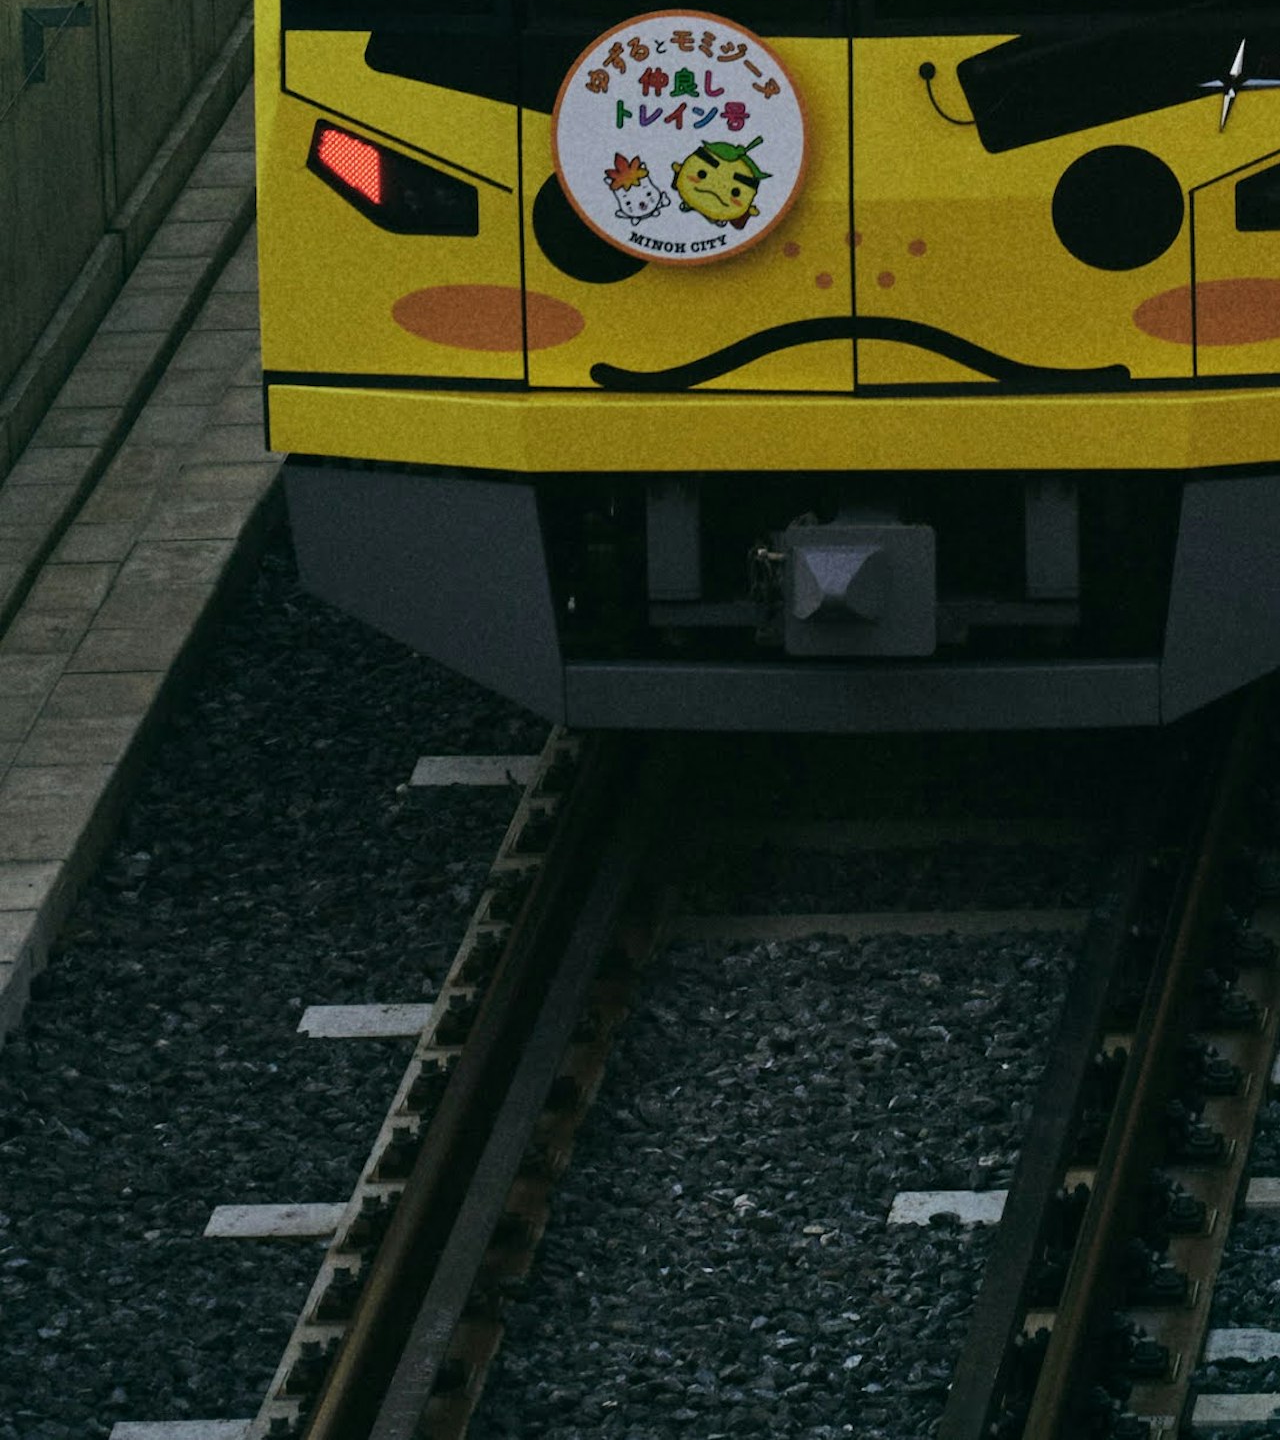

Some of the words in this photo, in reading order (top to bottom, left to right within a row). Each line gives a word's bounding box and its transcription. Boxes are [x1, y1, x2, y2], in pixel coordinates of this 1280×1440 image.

[638, 67, 725, 97] 仲良し
[614, 99, 751, 131] トレイン号
[628, 231, 687, 254] MINOH
[690, 233, 729, 253] CITY
